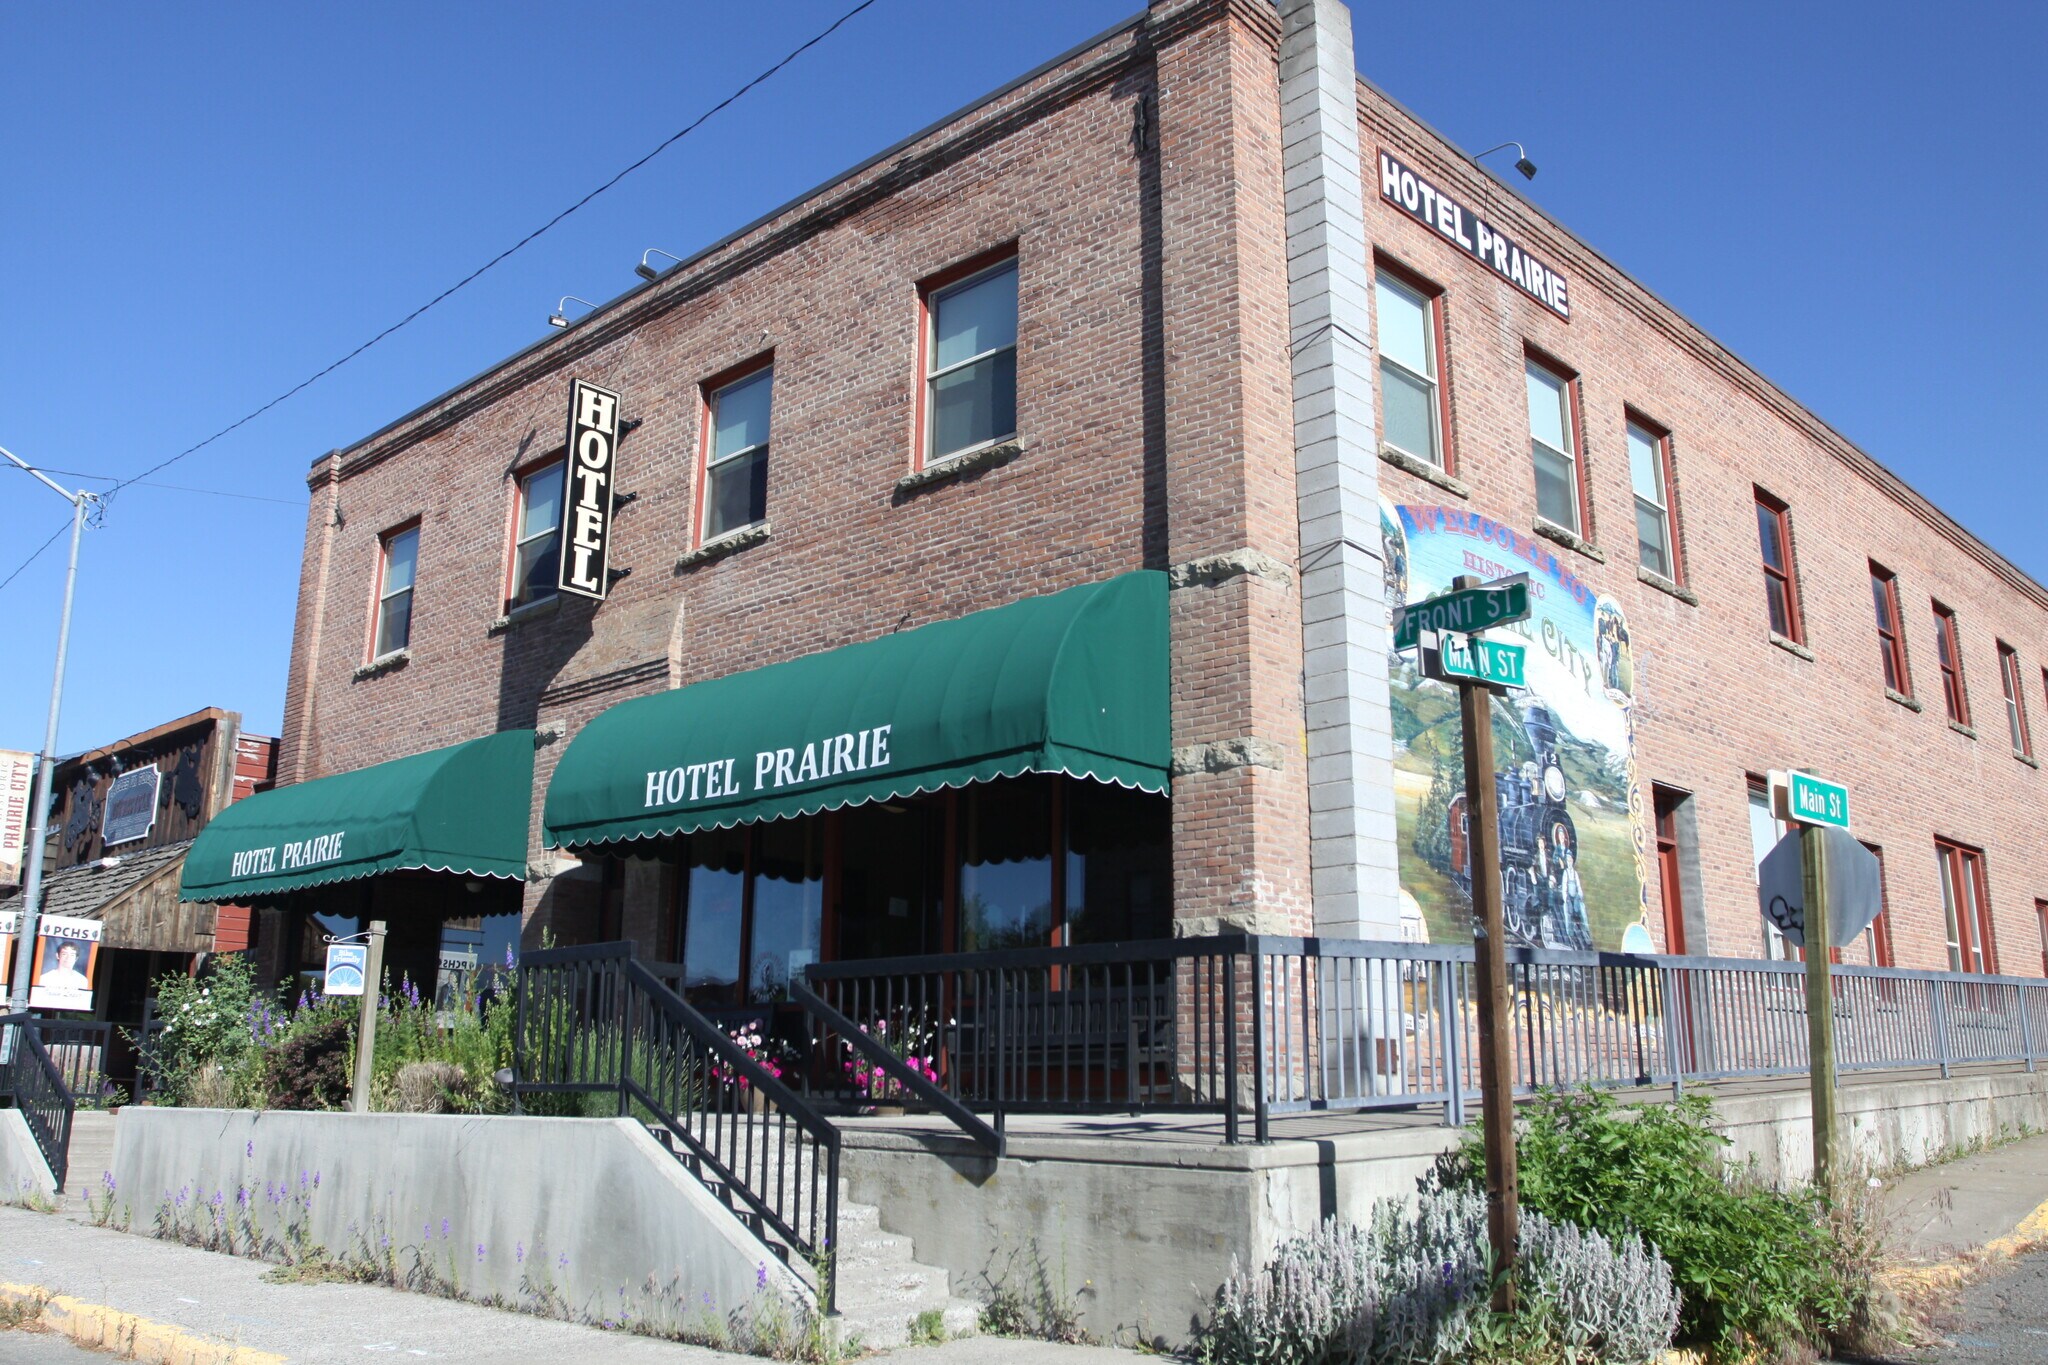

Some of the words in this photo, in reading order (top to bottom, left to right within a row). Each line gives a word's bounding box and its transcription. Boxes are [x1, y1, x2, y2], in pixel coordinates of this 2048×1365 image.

[1381, 154, 1472, 251] HOTEL
[1476, 220, 1569, 316] PRAIRIE
[571, 387, 615, 592] HOTEL
[1405, 505, 1551, 576] WELCOME
[1556, 560, 1587, 605] TO
[1462, 549, 1546, 600] HISTIC
[1405, 596, 1474, 640] FRONT
[1497, 649, 1517, 679] ST
[1541, 616, 1592, 698] CITY
[10, 761, 29, 791] CITY
[644, 758, 740, 808] HOTEL
[753, 724, 892, 791] PRAIRIE
[3, 796, 24, 850] PRAIRIE
[1799, 783, 1826, 815] Main
[1829, 792, 1842, 819] St
[231, 847, 276, 877] HOTEL
[281, 831, 345, 870] PRAIRIE
[53, 926, 89, 939] PCHS
[333, 955, 361, 965] Friendly
